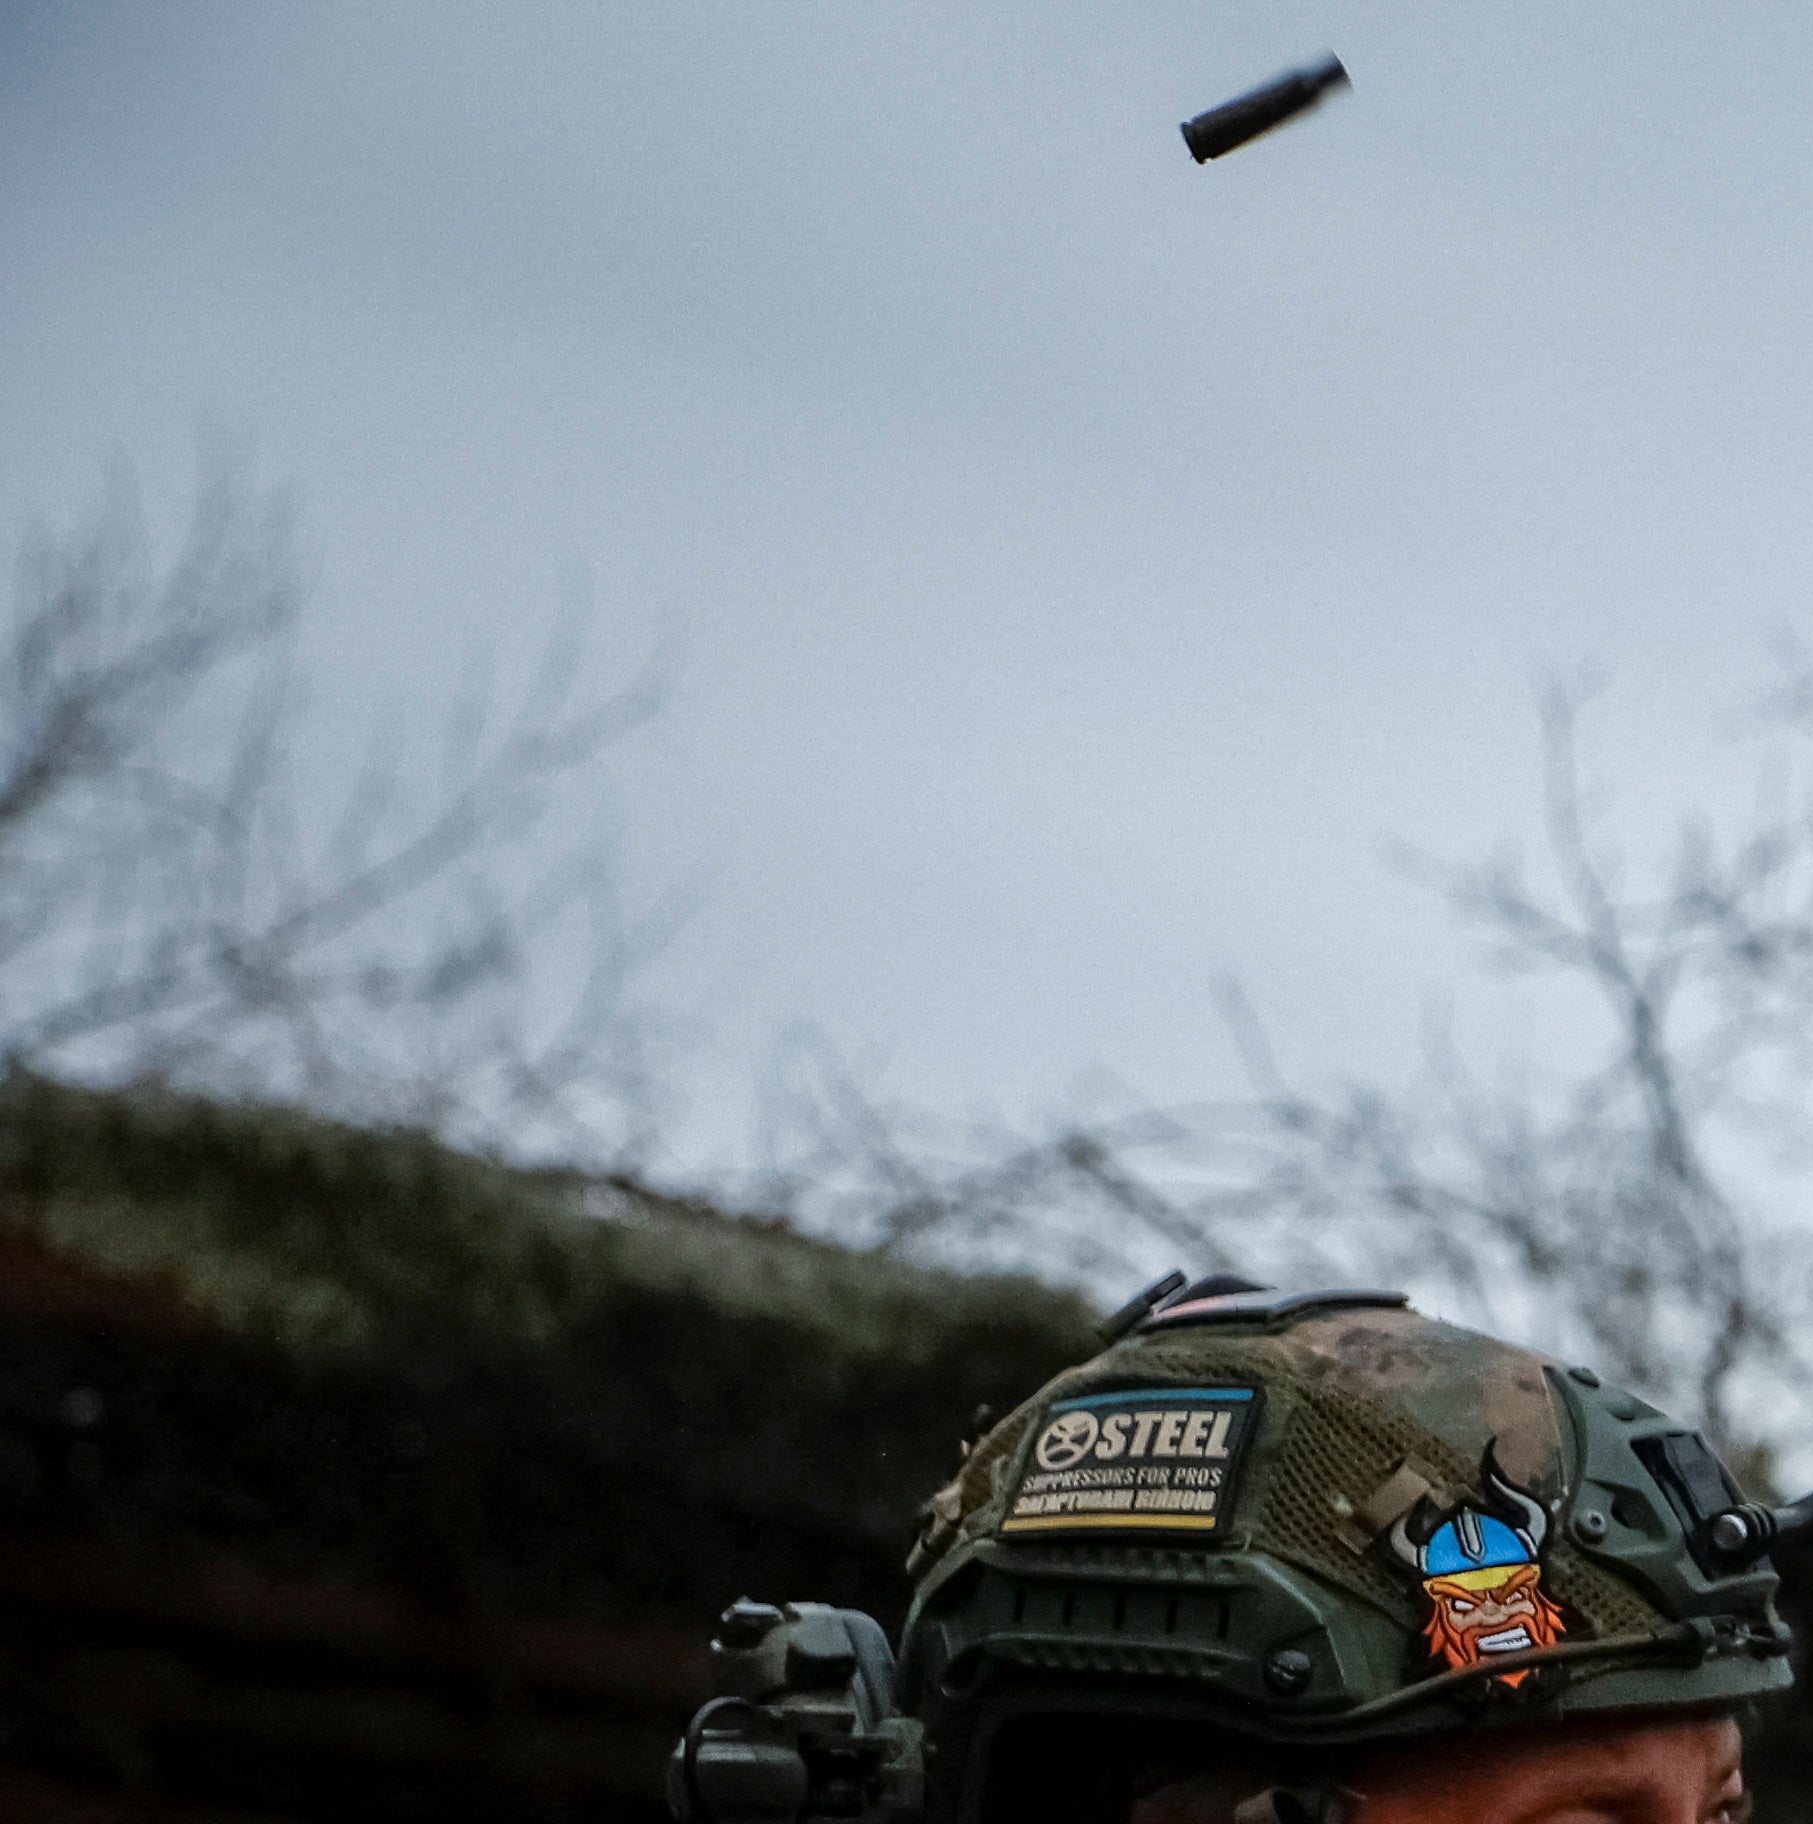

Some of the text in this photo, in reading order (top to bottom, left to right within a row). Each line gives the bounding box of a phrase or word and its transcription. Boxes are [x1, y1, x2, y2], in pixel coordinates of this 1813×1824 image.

[1095, 1410, 1232, 1460] STEEL
[1023, 1467, 1135, 1492] SUPPRESSORS
[1137, 1467, 1171, 1485] FOR
